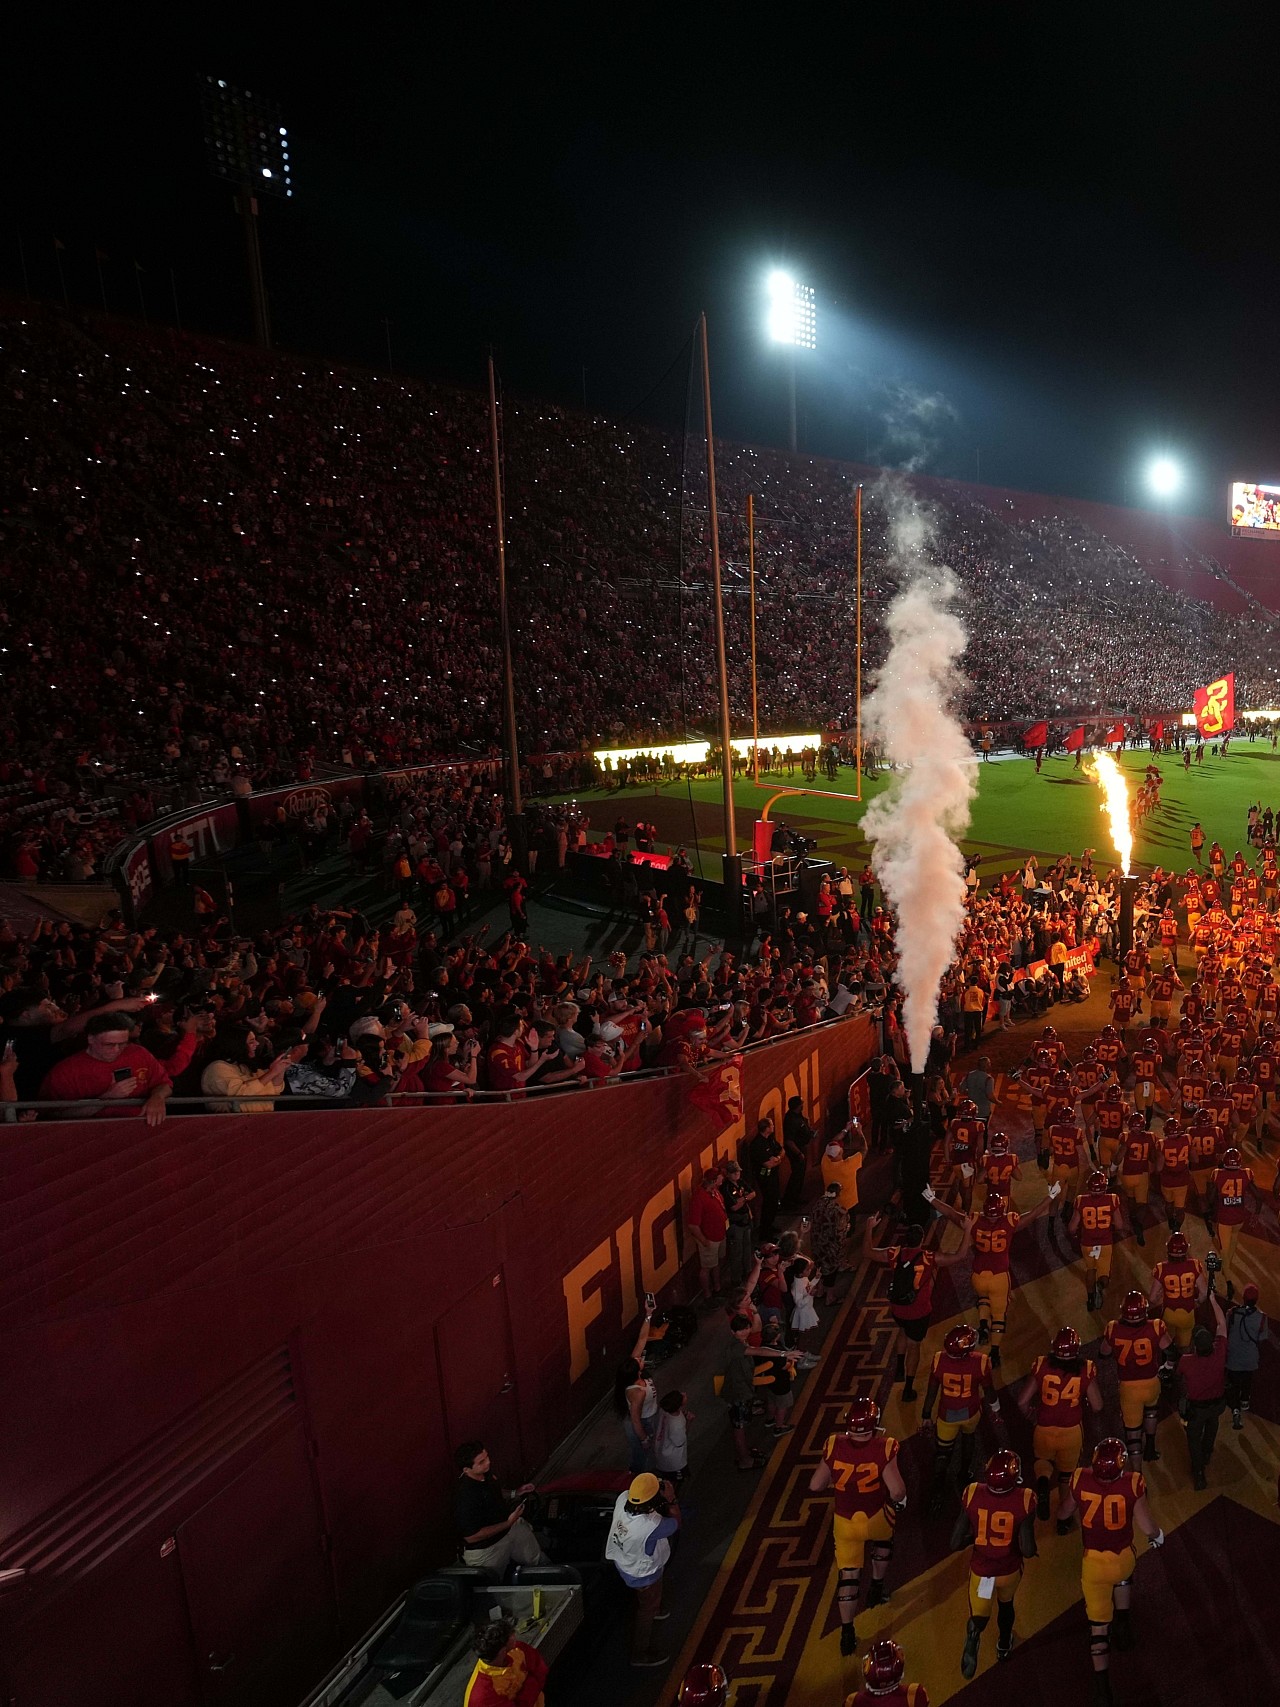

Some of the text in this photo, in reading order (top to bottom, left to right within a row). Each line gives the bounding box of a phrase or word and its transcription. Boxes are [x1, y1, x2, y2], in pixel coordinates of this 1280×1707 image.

[1207, 885, 1214, 894] 2
[1186, 898, 1198, 908] 93
[1065, 951, 1087, 968] nited
[1128, 956, 1140, 968] 61
[1063, 964, 1093, 982] Retals
[1246, 972, 1260, 984] 36
[1155, 980, 1171, 995] 76
[1264, 988, 1276, 1000] 15
[1116, 995, 1131, 1009] 48
[1222, 1033, 1240, 1048] 79
[1100, 1045, 1118, 1061] 62
[1135, 1060, 1154, 1077] 30
[1260, 1062, 1270, 1078] 9
[1078, 1071, 1097, 1088] 38
[758, 1049, 820, 1150] ON!
[1183, 1085, 1204, 1102] 99
[1100, 1111, 1121, 1129] 39
[957, 1128, 969, 1143] 9
[1052, 1136, 1075, 1155] 53
[1129, 1142, 1149, 1161] 31
[1165, 1145, 1189, 1166] 54
[1221, 1178, 1243, 1197] 41
[1082, 1206, 1111, 1230] 85
[975, 1229, 1007, 1253] 56
[1164, 1272, 1196, 1299] 98
[1114, 1337, 1153, 1366] 79
[942, 1374, 973, 1398] 51
[1041, 1375, 1081, 1407] 64
[832, 1460, 881, 1493] 72
[1081, 1491, 1127, 1531] 70
[977, 1508, 1015, 1546] 19
